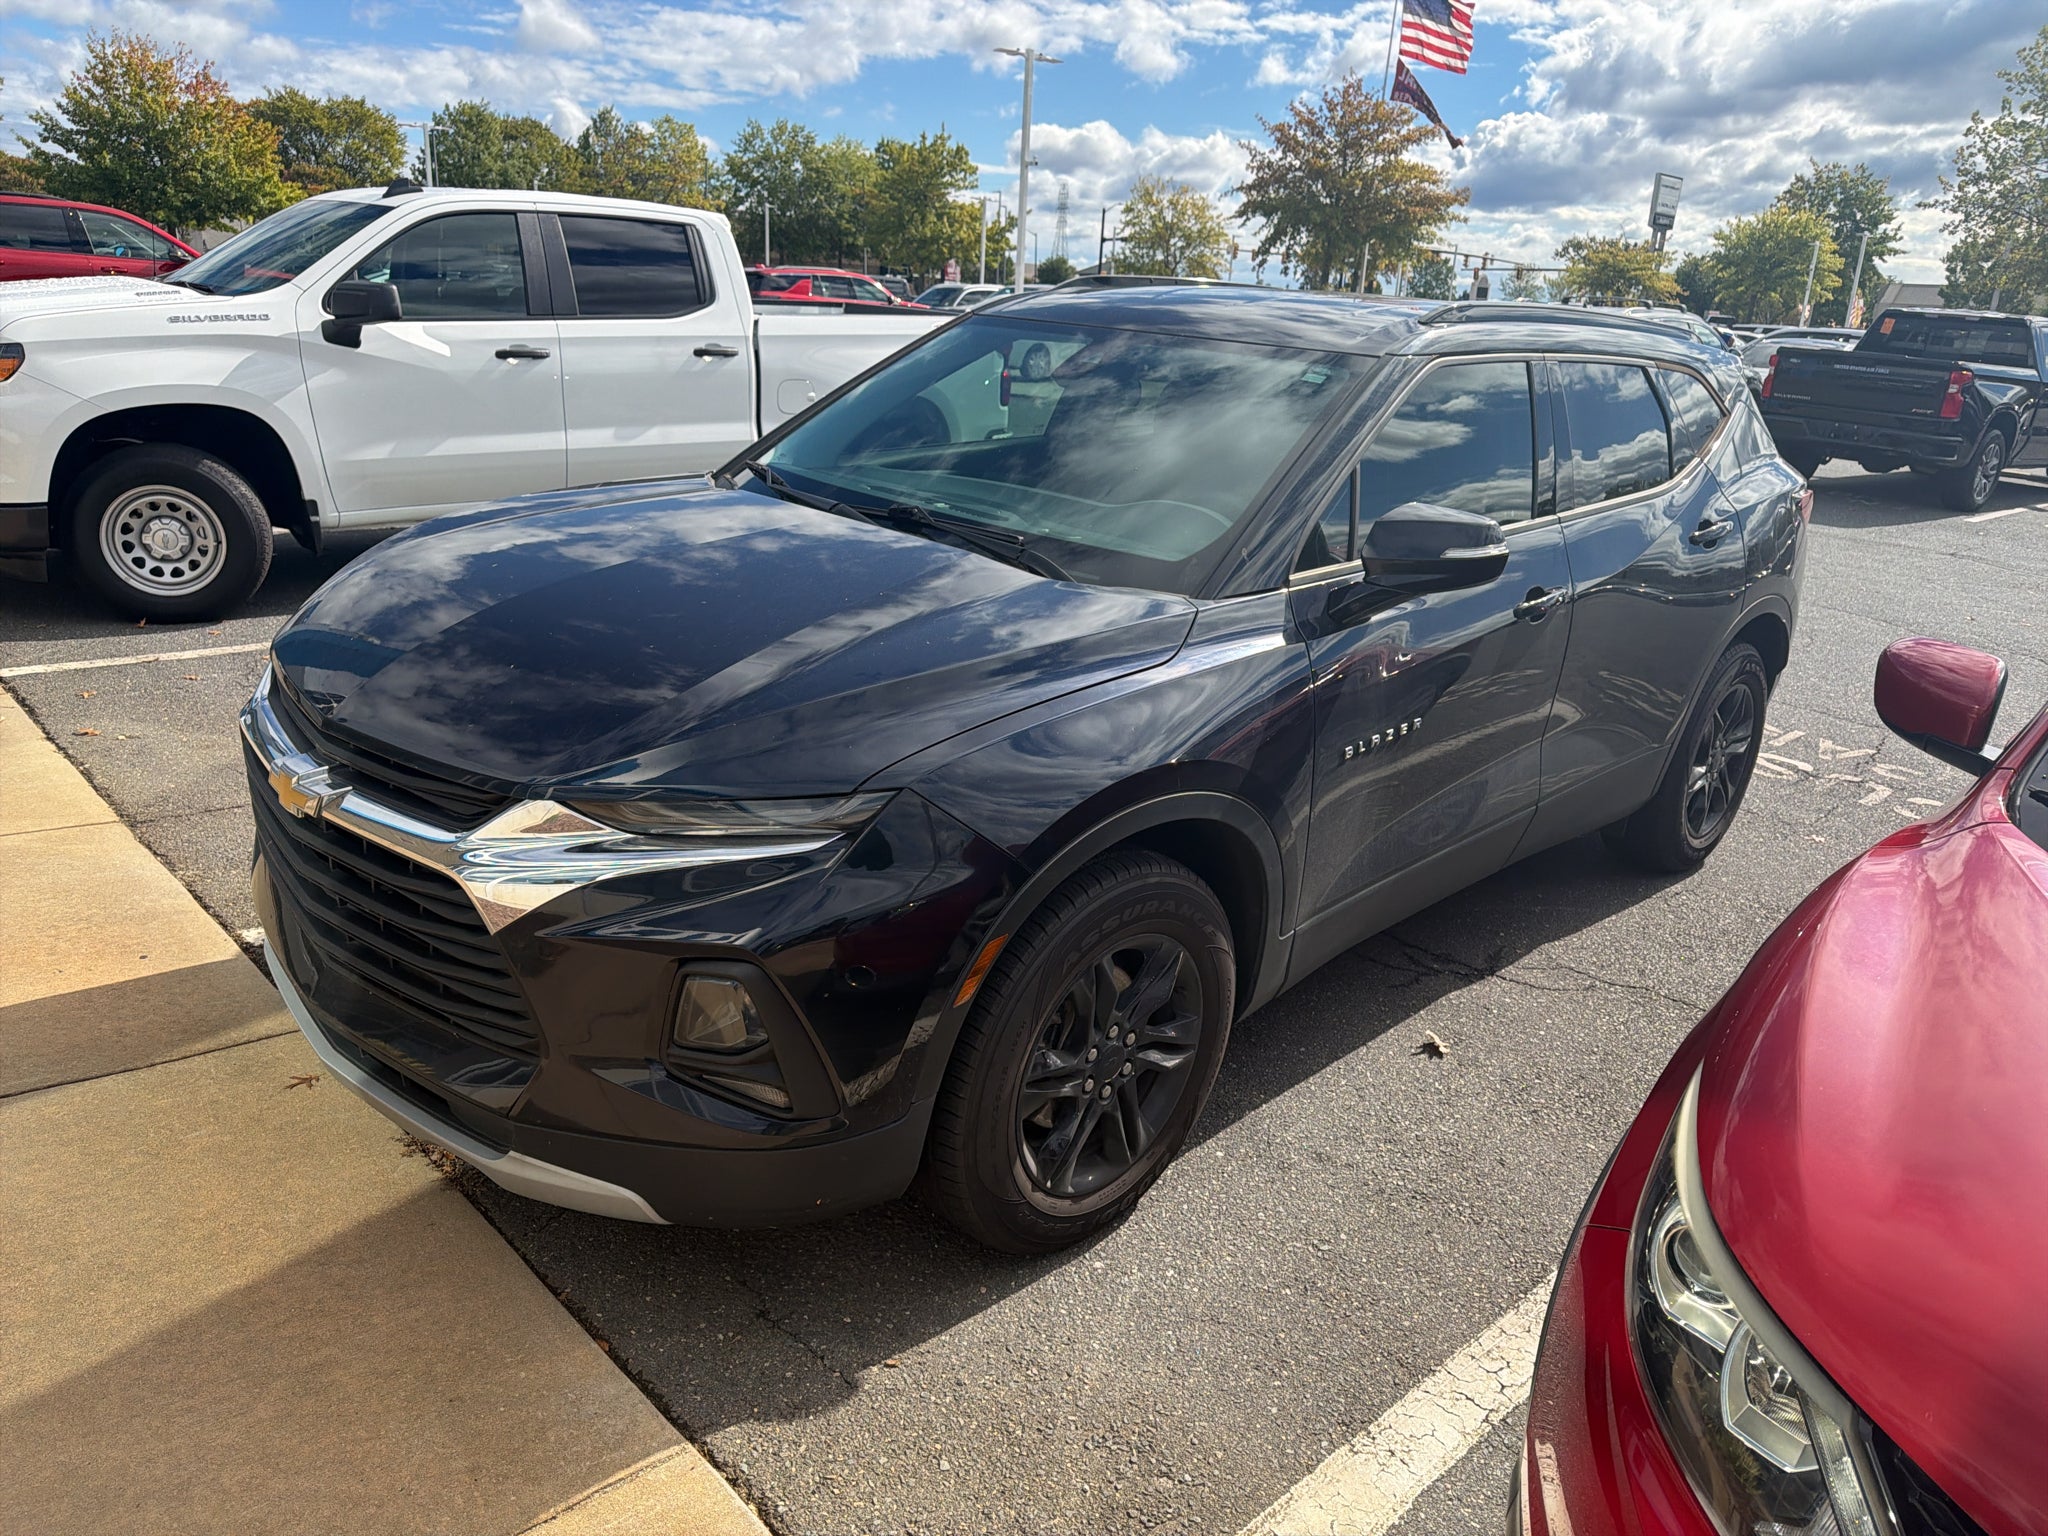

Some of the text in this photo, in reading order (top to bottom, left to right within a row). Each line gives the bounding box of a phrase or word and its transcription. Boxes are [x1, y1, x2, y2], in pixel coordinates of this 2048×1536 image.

[167, 313, 271, 324] SILVERADO
[1344, 717, 1423, 760] BLAZER
[1062, 899, 1218, 972] ASSURANCE
